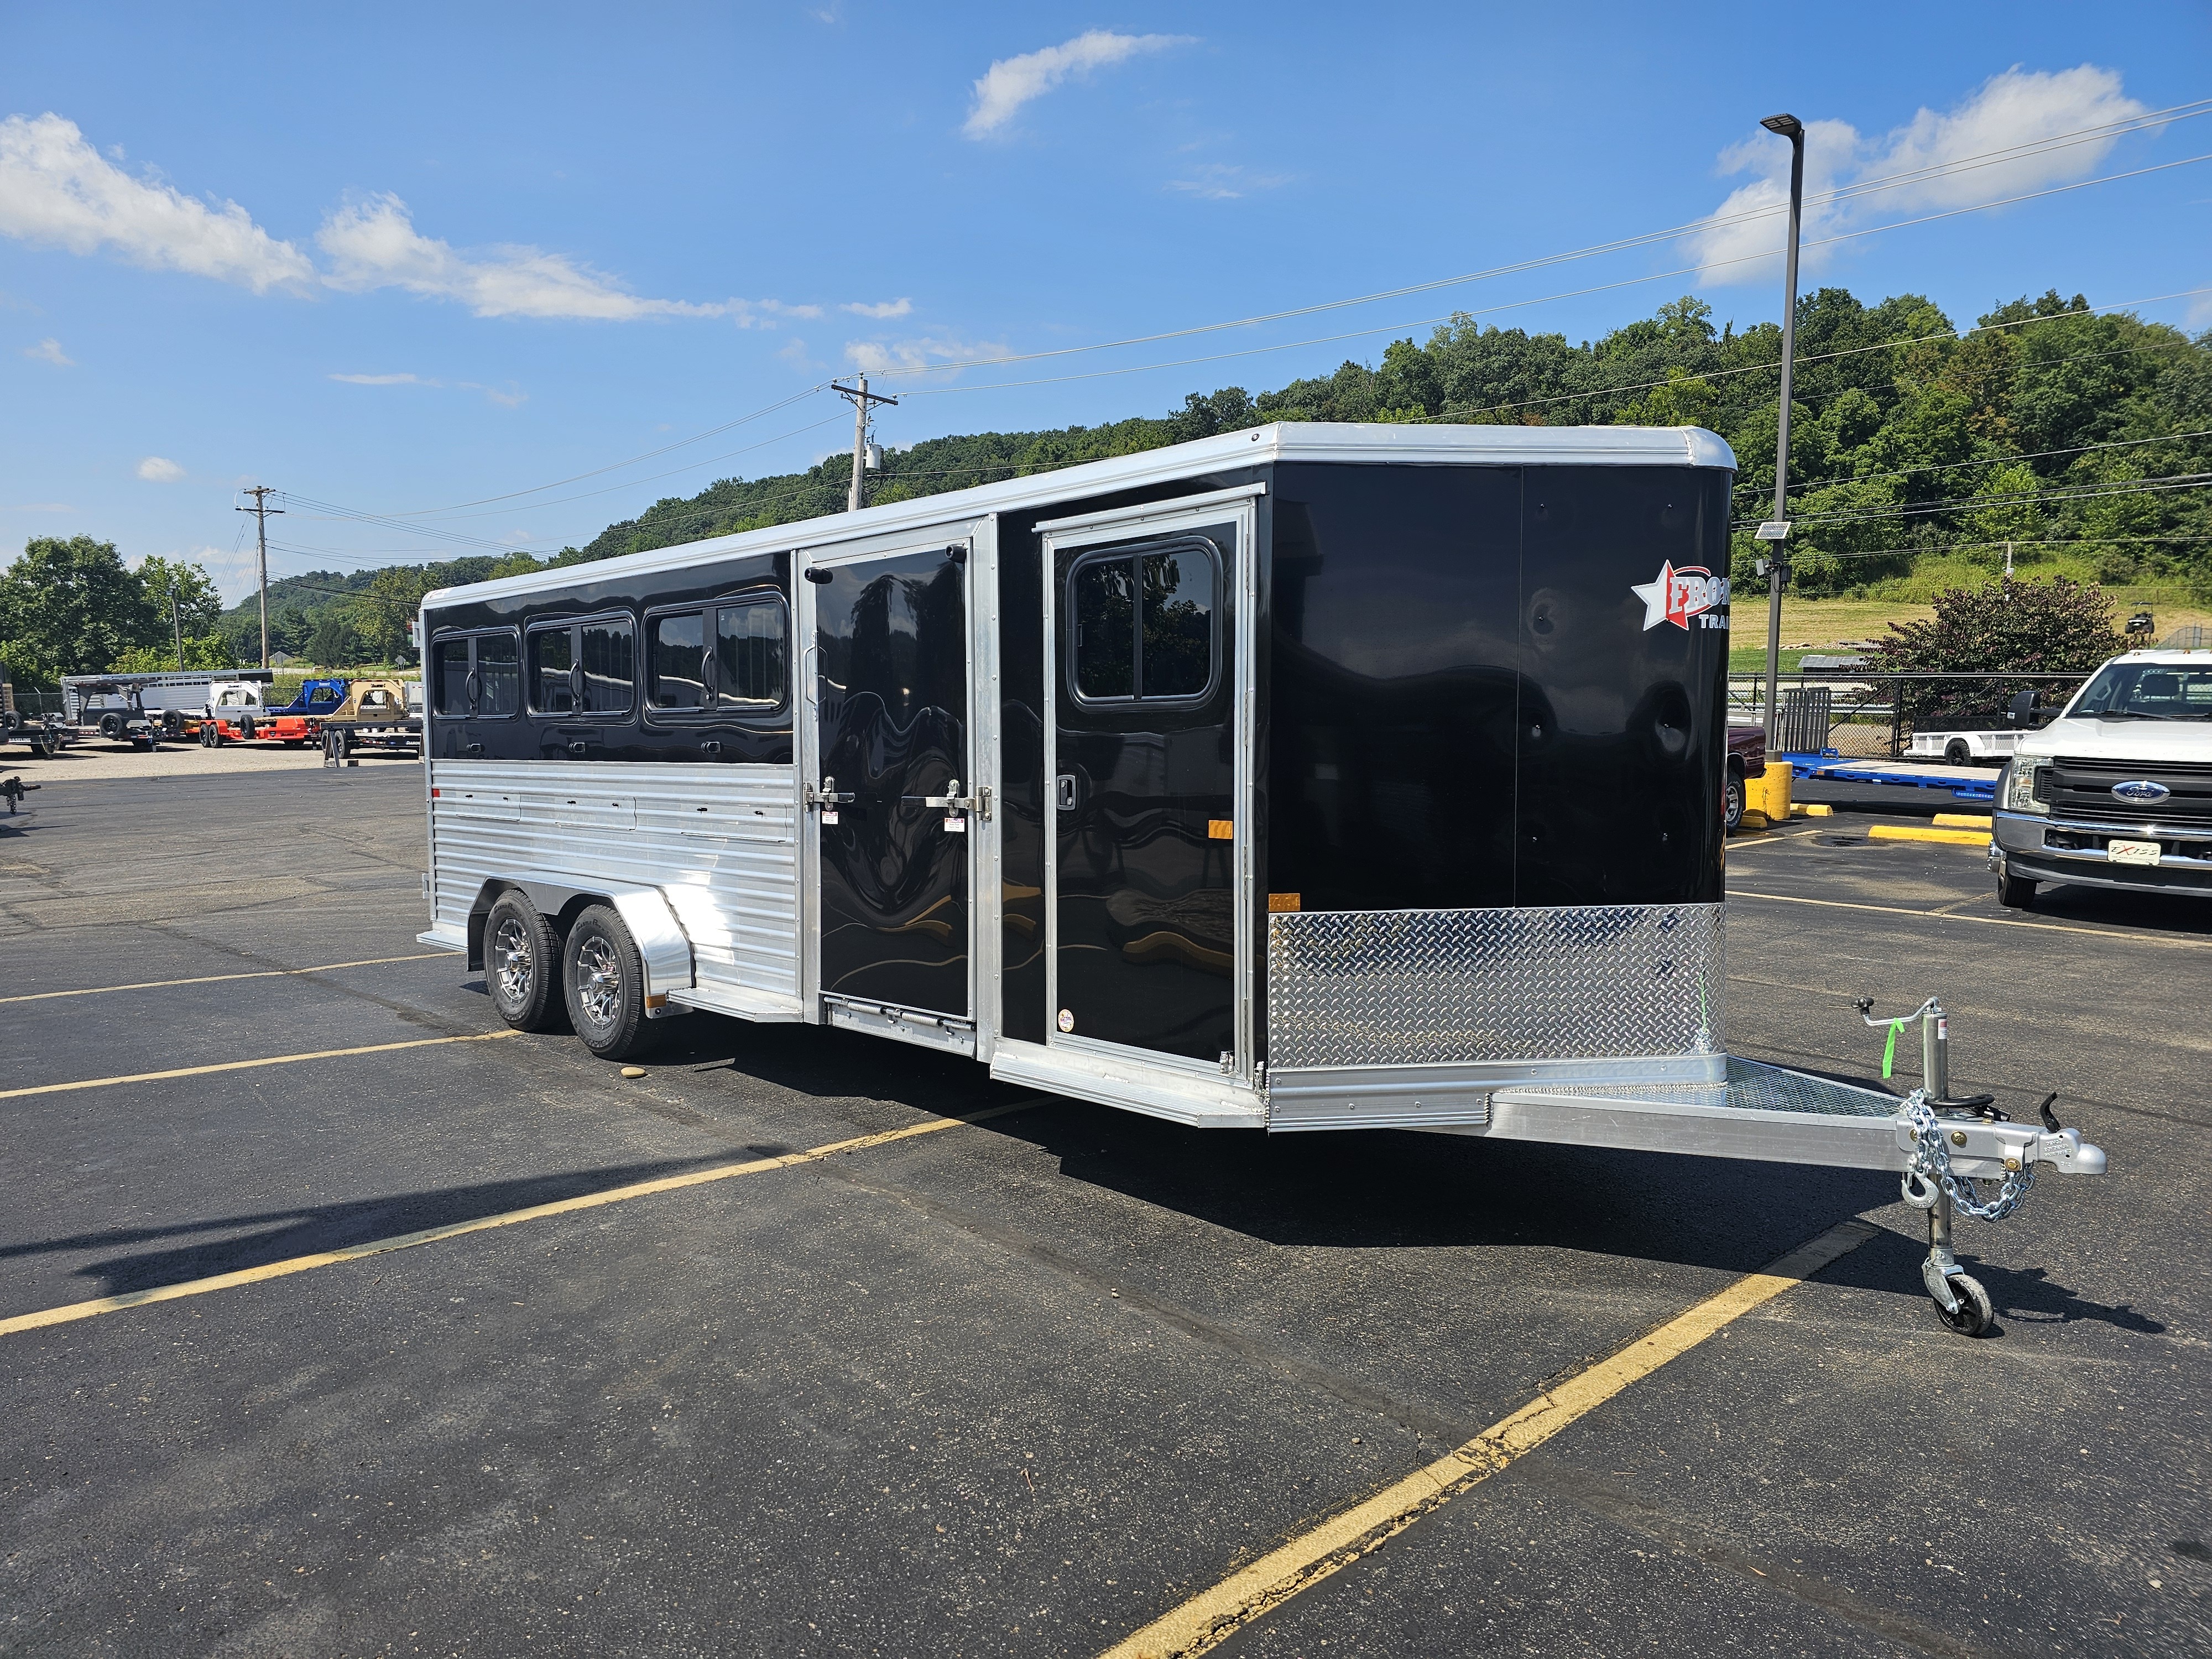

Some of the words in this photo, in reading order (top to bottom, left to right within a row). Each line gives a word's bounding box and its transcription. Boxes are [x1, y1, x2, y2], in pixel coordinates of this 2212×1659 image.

[1699, 614, 1730, 629] TRAI
[2126, 786, 2154, 797] Ford
[2111, 845, 2158, 855] EXISS
